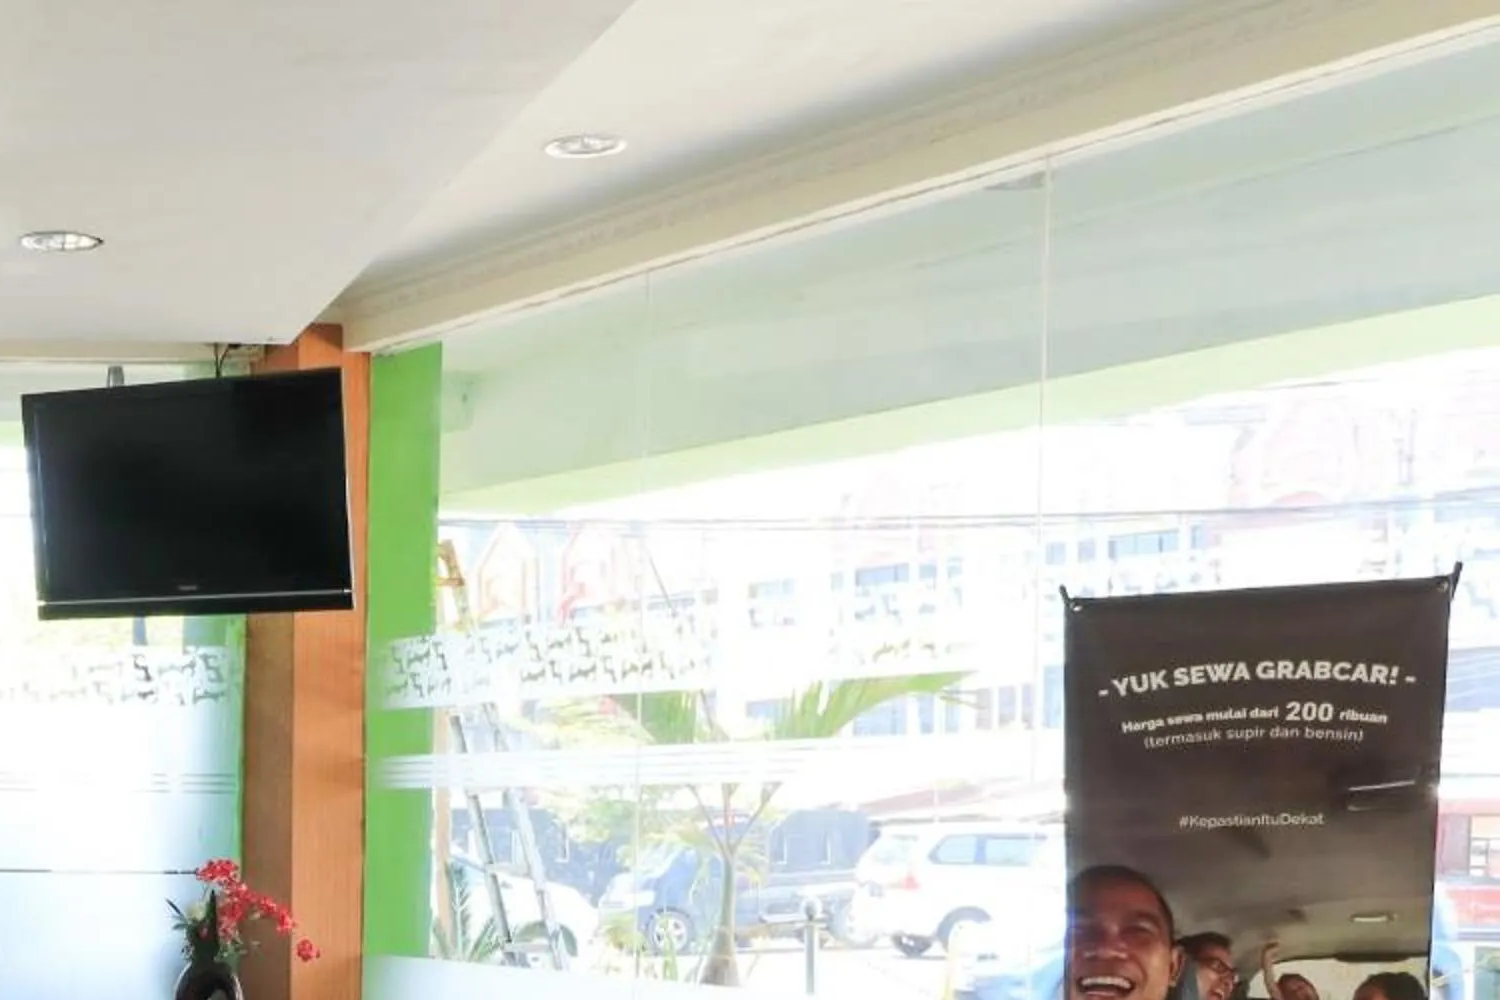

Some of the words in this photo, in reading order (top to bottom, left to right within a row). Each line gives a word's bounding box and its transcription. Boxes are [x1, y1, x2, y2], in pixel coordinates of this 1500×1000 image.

[1111, 669, 1169, 697] YUK
[1173, 661, 1251, 687] SEWA
[1255, 660, 1400, 685] GRABCAR!
[1121, 718, 1165, 733] Harga
[1167, 713, 1203, 726] sewa
[1205, 707, 1247, 721] mulai
[1249, 706, 1279, 719] dari
[1285, 701, 1334, 722] 200
[1339, 709, 1388, 724] ribuan
[1143, 729, 1222, 749] (termasuk
[1226, 725, 1266, 741] supir
[1269, 726, 1301, 739] dan
[1304, 727, 1364, 742] bensin)
[1179, 812, 1324, 830] #KepastianItuDekat
